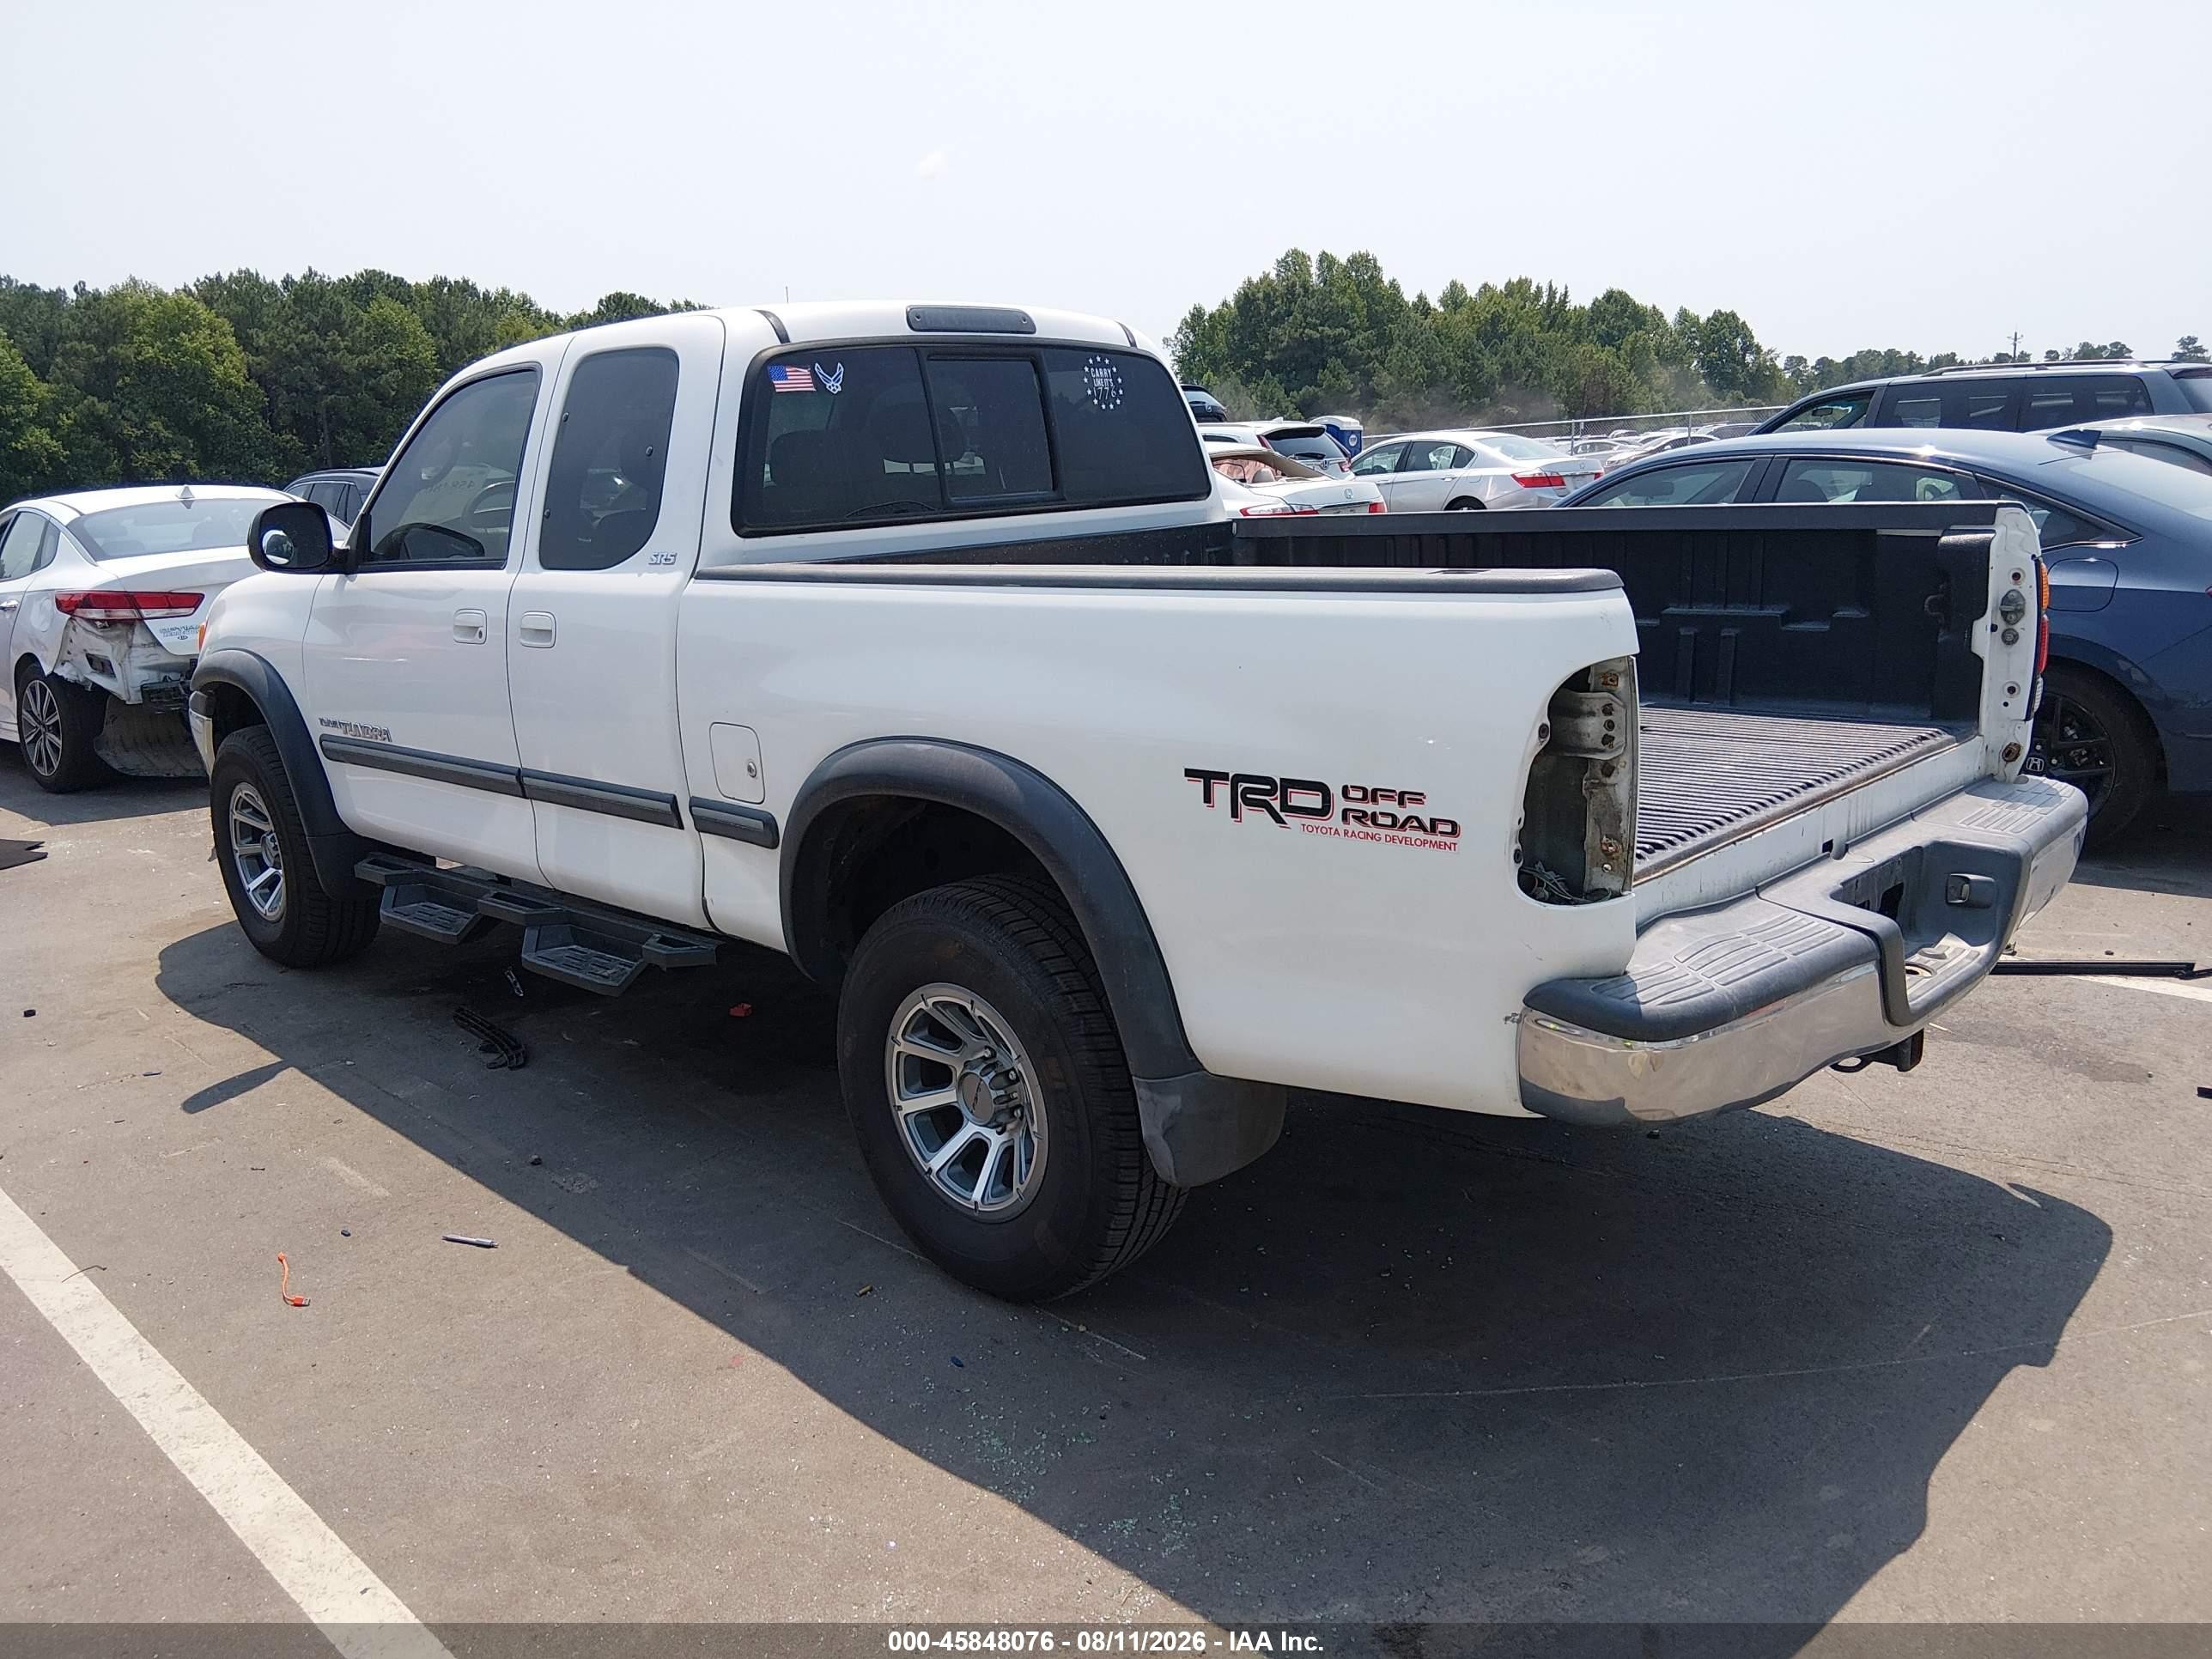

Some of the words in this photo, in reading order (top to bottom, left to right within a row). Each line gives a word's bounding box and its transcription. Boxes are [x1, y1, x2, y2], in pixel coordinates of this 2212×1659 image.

[1091, 368, 1112, 378] CARRY
[1093, 378, 1104, 387] LIKE
[1093, 385, 1117, 400] 1776
[1183, 768, 1334, 830] TRD
[1340, 784, 1427, 808] OFF
[1340, 807, 1462, 839] ROAD
[1301, 823, 1340, 837] TOYOTA
[1343, 829, 1382, 842] RACING
[1384, 834, 1458, 852] DEVELOPMENT
